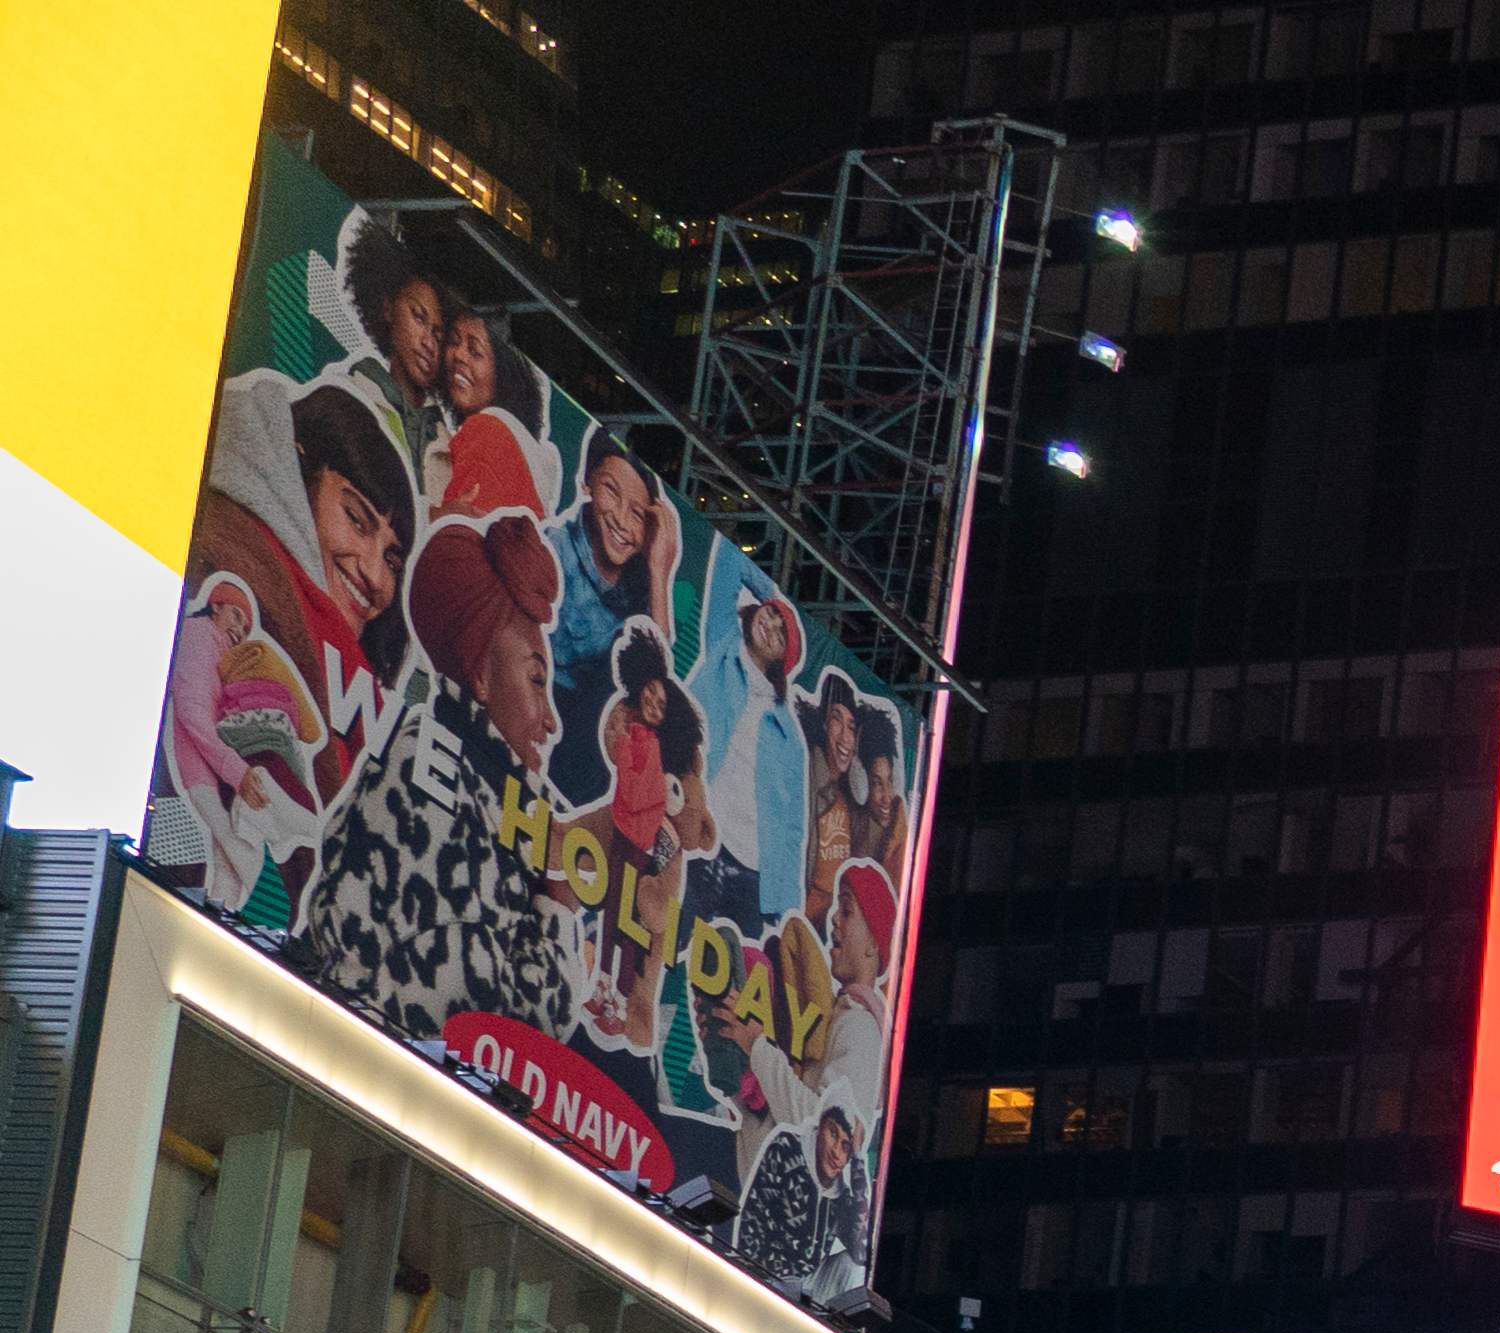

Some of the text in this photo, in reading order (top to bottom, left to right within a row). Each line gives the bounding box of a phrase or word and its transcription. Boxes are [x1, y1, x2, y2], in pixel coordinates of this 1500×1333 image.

[320, 642, 465, 812] WE
[500, 774, 828, 1064] HOLIDAY
[552, 1081, 652, 1172] NAVY
